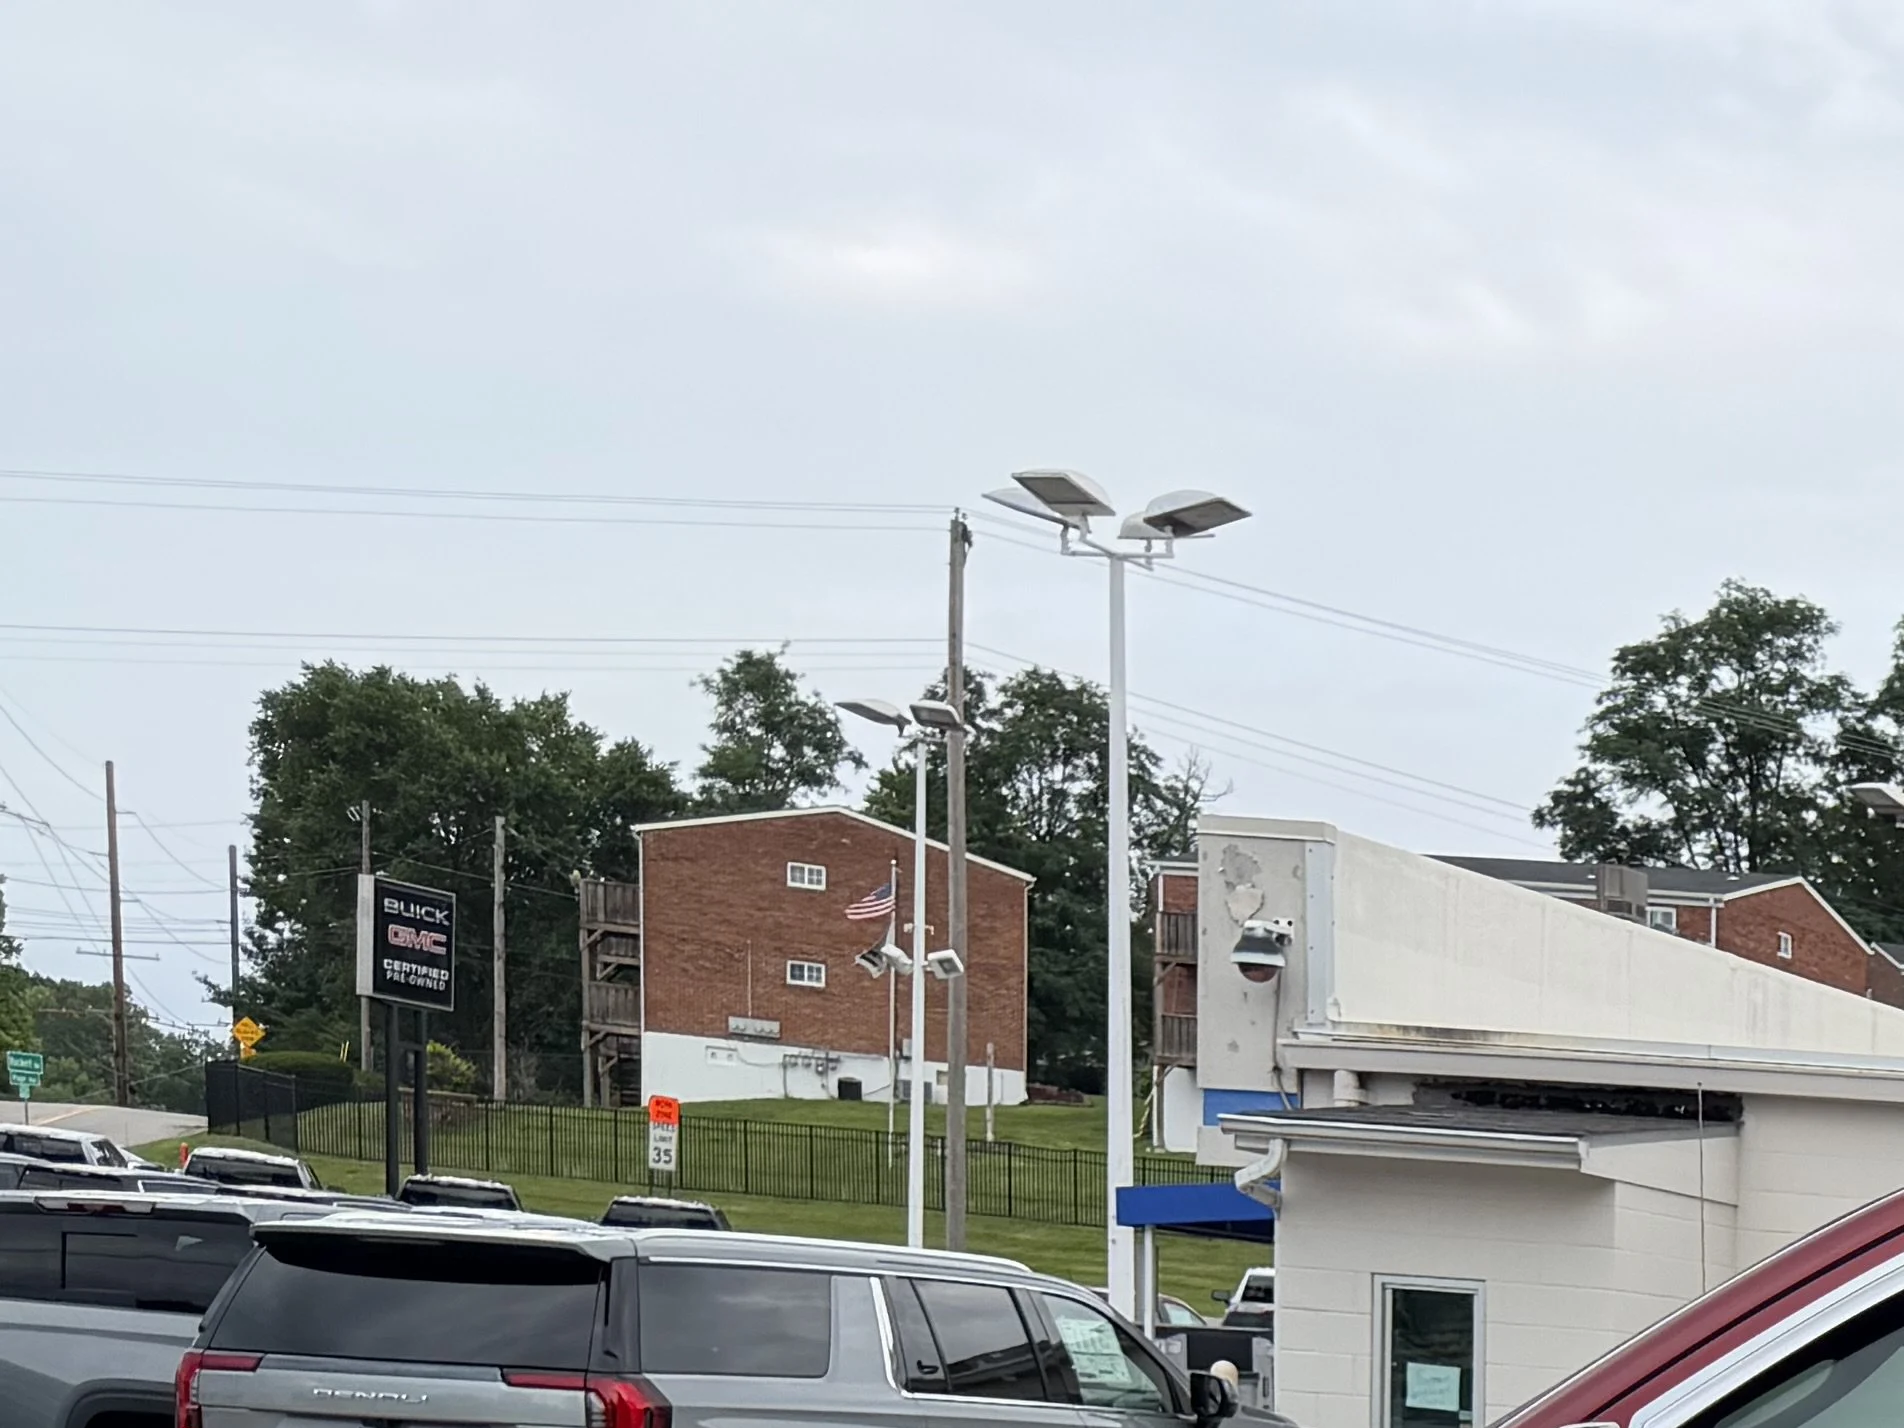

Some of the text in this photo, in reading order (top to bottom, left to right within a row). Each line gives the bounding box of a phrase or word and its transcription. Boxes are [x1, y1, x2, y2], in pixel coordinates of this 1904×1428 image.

[383, 897, 451, 926] BUICK
[387, 923, 448, 955] GMC
[383, 958, 450, 981] CERTIFIED
[652, 1146, 673, 1165] 35
[313, 1387, 428, 1404] DENALI
